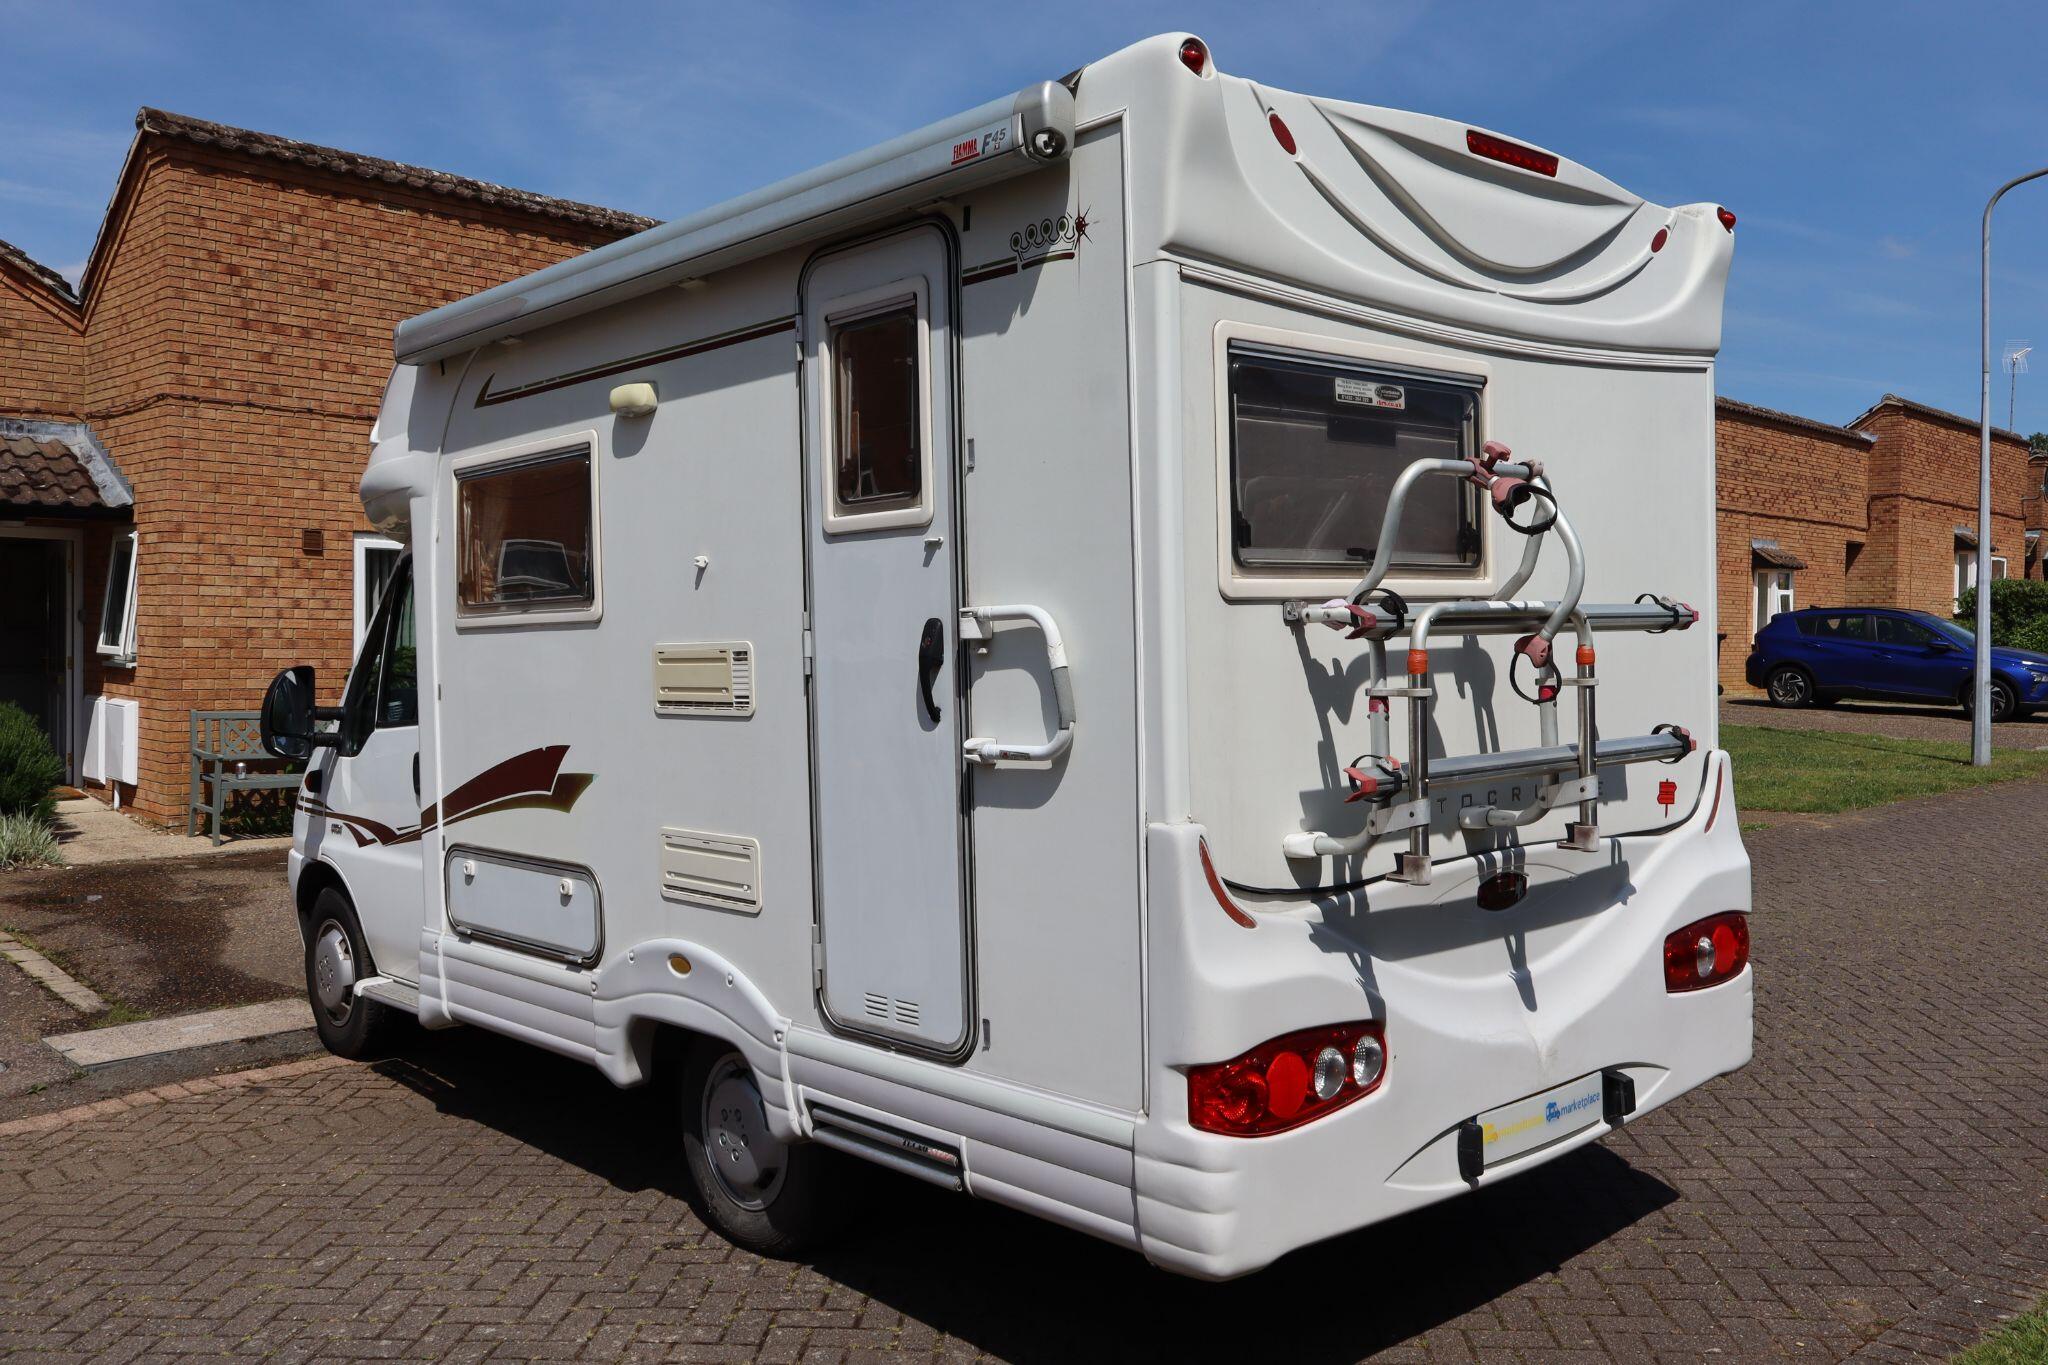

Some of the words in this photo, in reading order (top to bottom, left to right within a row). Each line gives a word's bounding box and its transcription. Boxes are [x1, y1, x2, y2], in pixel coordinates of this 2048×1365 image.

[953, 138, 978, 160] FIAMMA
[982, 128, 1007, 155] F45
[1560, 1091, 1601, 1116] marketplace
